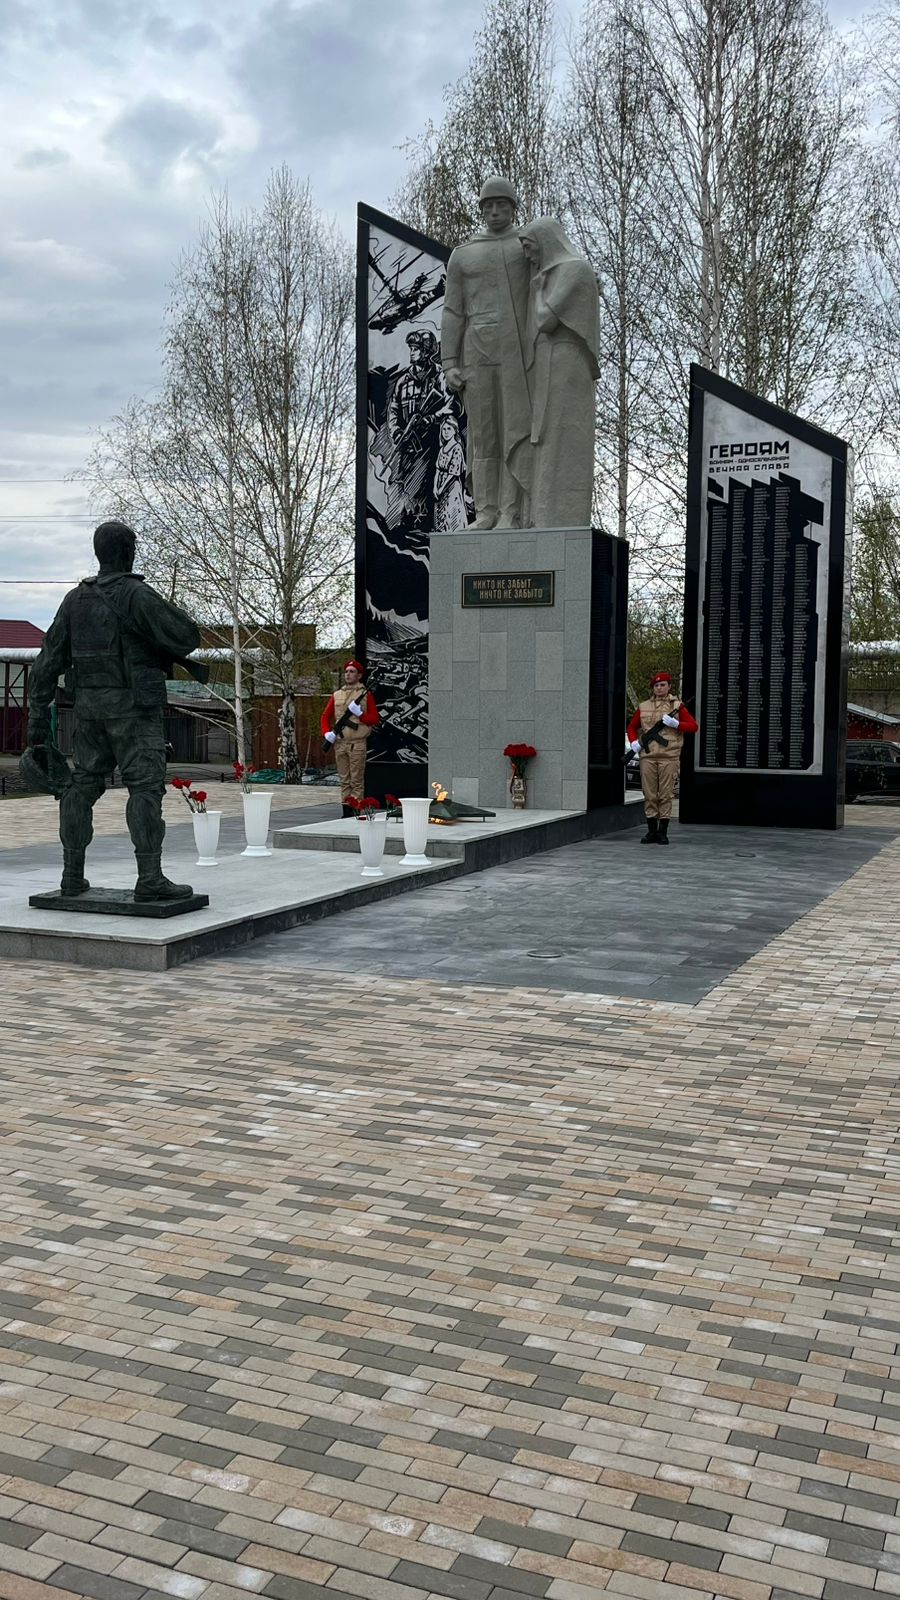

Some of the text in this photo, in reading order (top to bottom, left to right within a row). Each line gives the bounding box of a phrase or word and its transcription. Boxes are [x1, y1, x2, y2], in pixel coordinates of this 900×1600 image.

[710, 441, 789, 458] ГЕРОЯМ
[709, 465, 749, 473] ВЕЧНАЯ
[473, 579, 531, 589] НИКТО НЕ ЗАБЫТ
[480, 588, 543, 599] НИЧТО НЕ ЗАБЫТО
